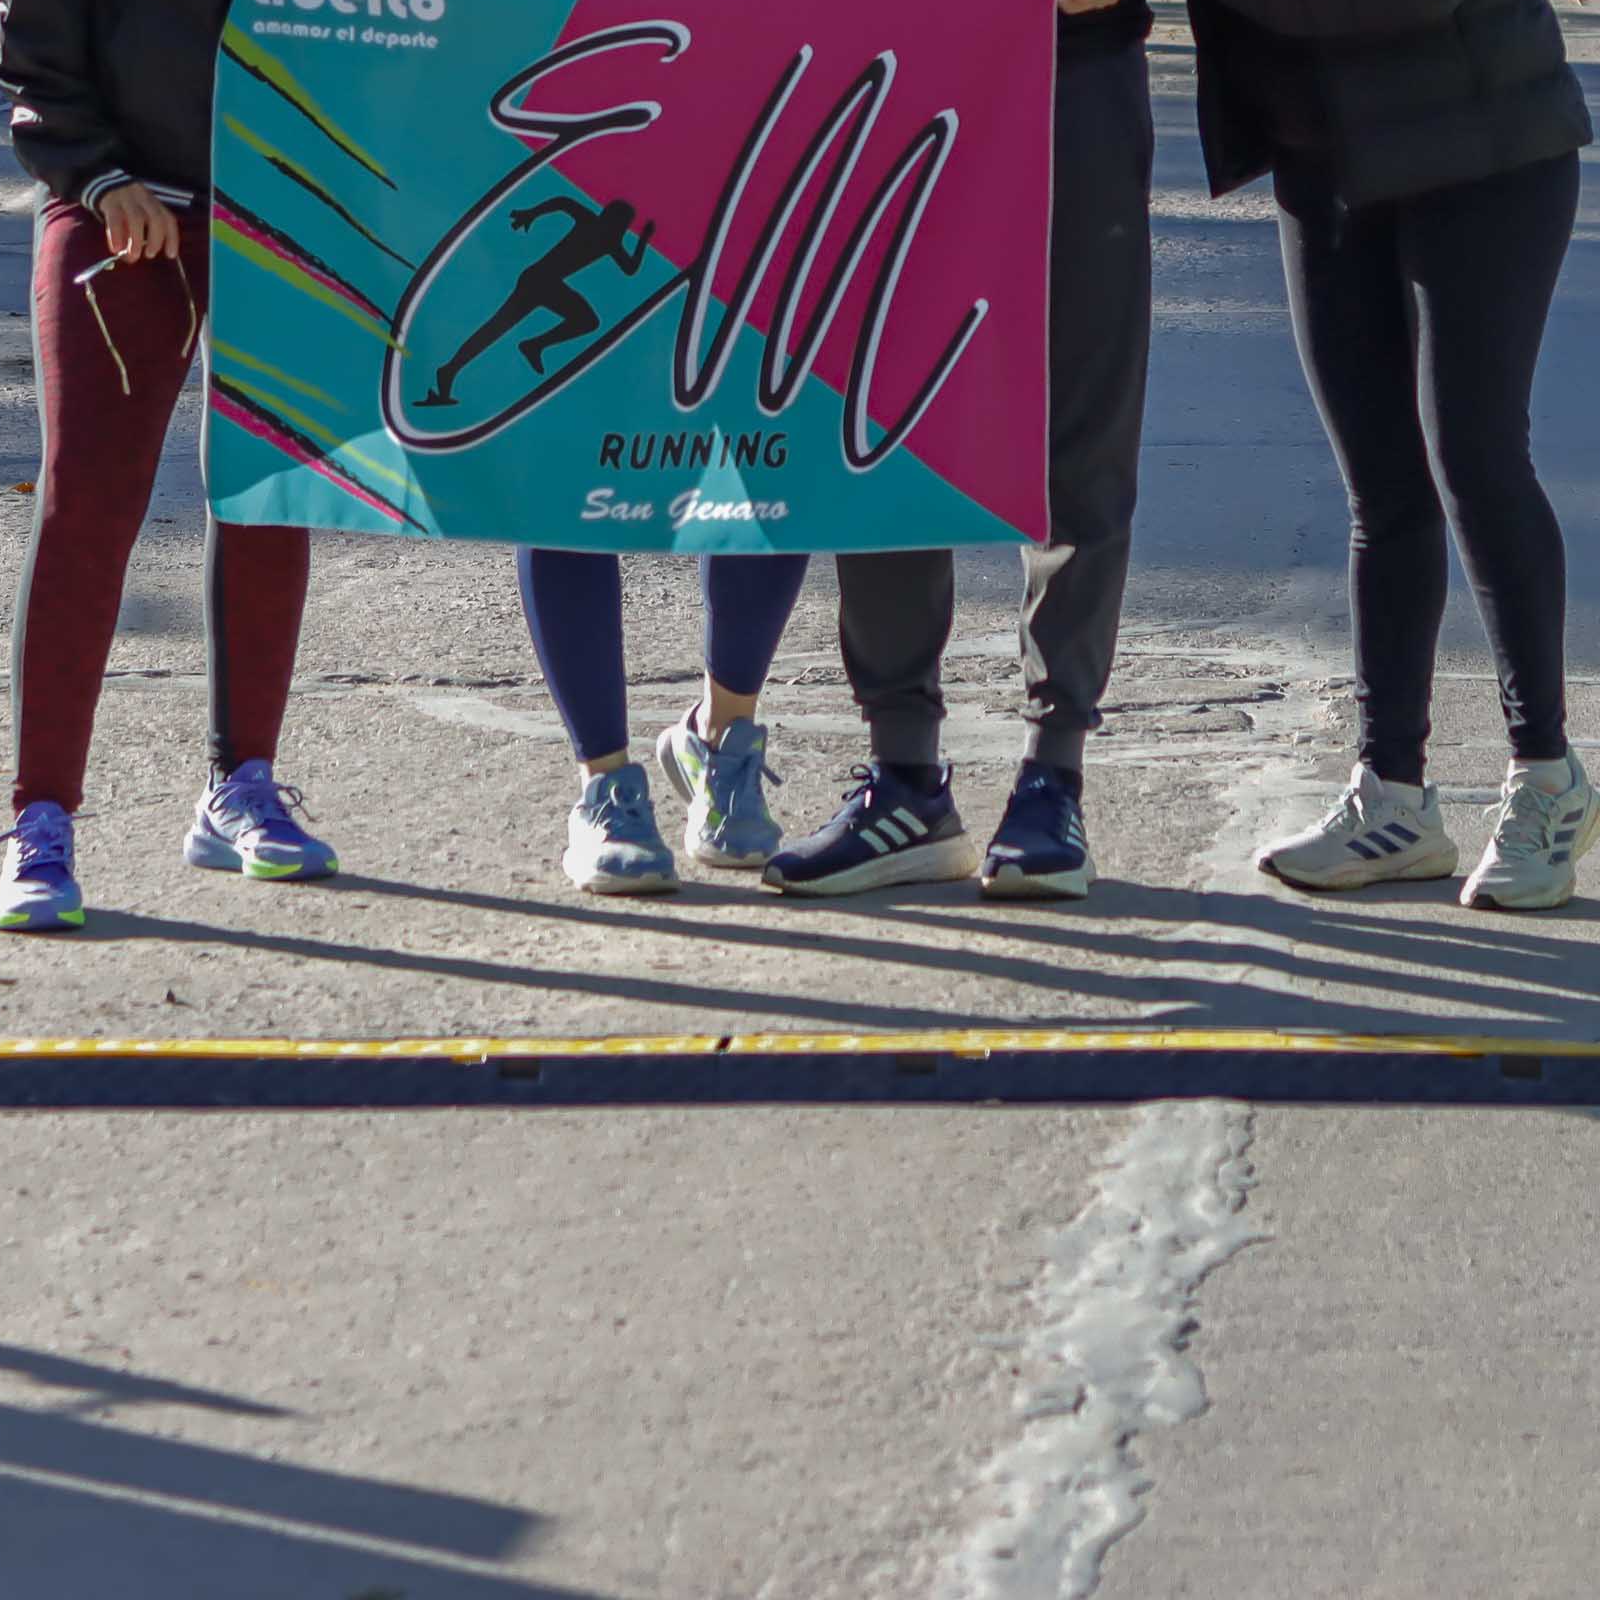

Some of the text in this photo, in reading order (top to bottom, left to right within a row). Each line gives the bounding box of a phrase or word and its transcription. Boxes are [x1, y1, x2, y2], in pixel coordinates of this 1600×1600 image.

[335, 26, 355, 42] el
[361, 27, 439, 49] deporte
[599, 431, 788, 471] RUNNING
[580, 487, 789, 531] San Genaro
